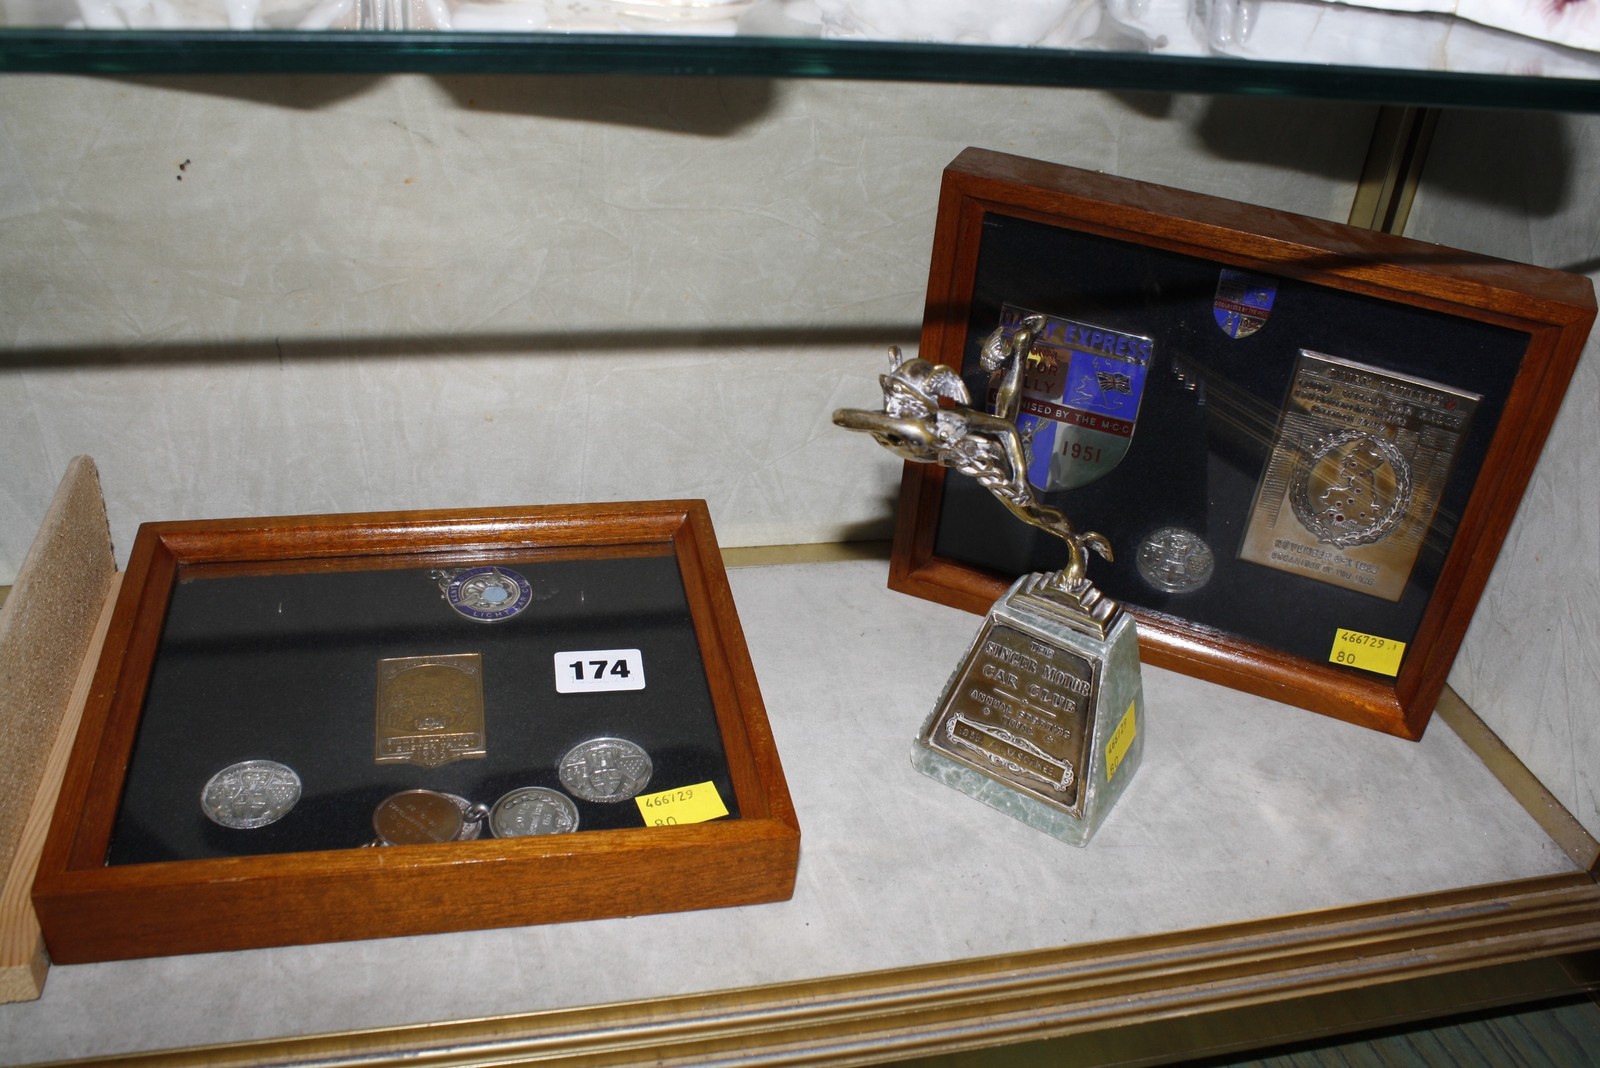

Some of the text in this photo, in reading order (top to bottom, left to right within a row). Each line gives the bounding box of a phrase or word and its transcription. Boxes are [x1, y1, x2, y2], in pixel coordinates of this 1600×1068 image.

[1064, 325, 1151, 361] EXPRESS
[1055, 409, 1070, 419] BY
[1075, 414, 1097, 426] THE
[1062, 440, 1103, 464] 1951
[473, 609, 511, 618] LIGHT
[1030, 641, 1056, 659] THE
[1336, 651, 1356, 665] 80
[569, 659, 631, 680] 174
[985, 640, 1091, 697] SINGER MOTOR
[982, 664, 1077, 713] CAR CLUB
[970, 689, 1013, 714] ANNUAL
